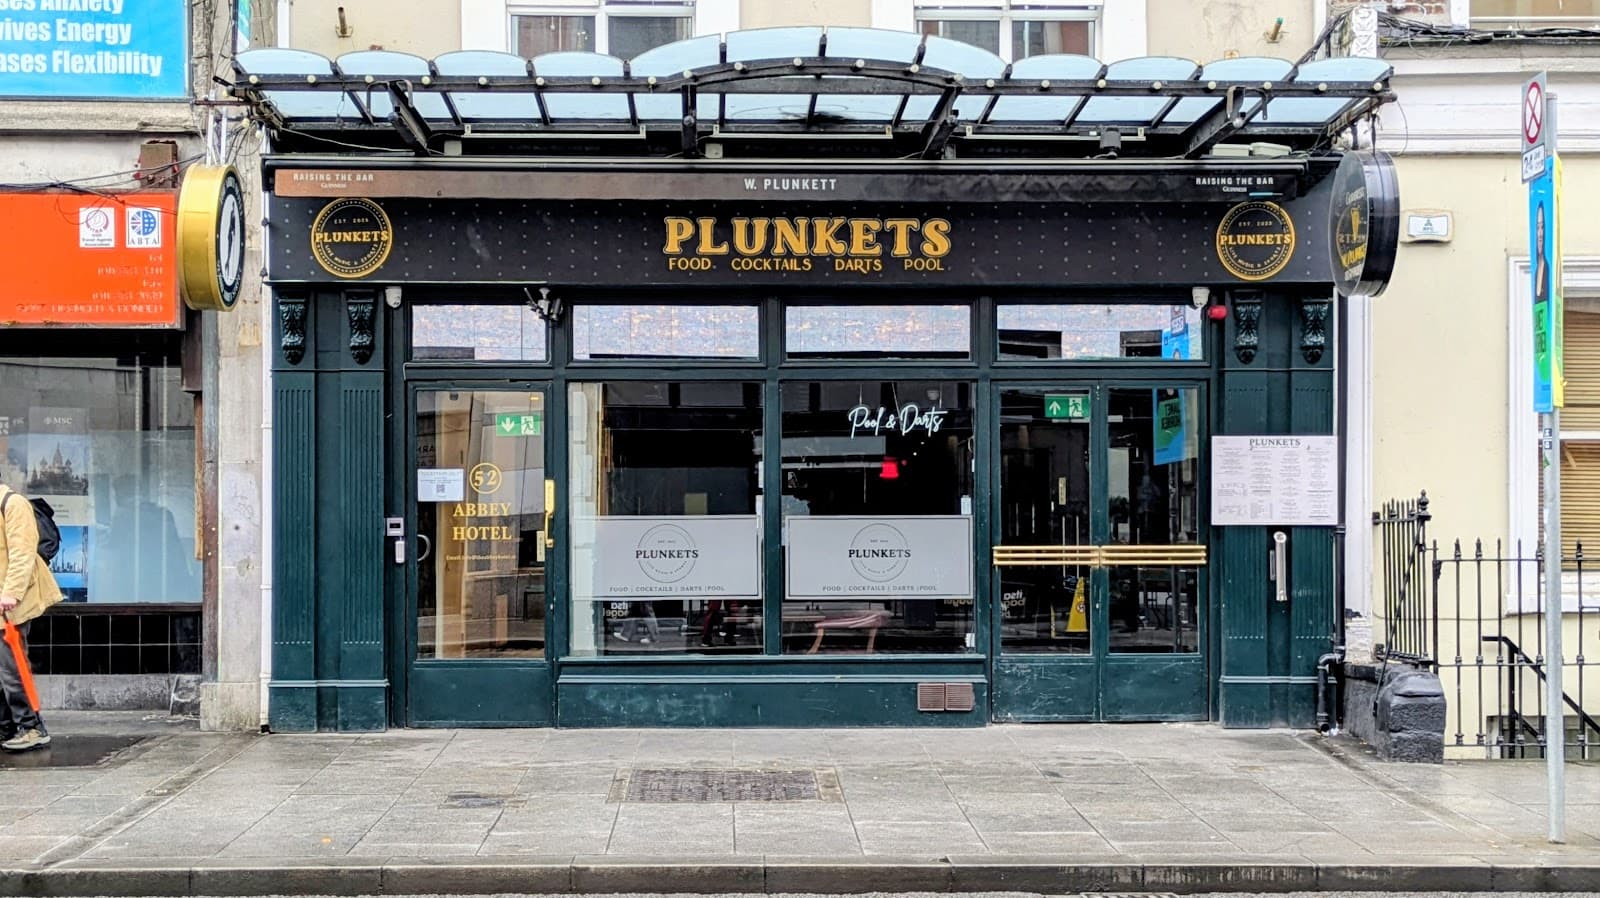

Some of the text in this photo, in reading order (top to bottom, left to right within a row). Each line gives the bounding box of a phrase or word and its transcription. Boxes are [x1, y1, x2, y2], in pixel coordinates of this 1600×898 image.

[56, 19, 132, 45] Energy
[52, 51, 163, 77] Flexibility
[293, 173, 374, 181] RAISING THE BAR
[744, 178, 837, 190] W. PLUNKETT
[1195, 177, 1274, 185] RAISING THE BAR
[315, 230, 390, 243] PLUNKETS
[662, 216, 952, 257] PLUNKETS
[1219, 233, 1292, 245] PLUNKETS
[668, 257, 944, 274] FOOD COCKTAILS DARTS POOL
[848, 404, 948, 439] Pool & Darts
[1249, 438, 1302, 447] PLUNKETS
[473, 470, 498, 487] 52
[452, 502, 513, 517] ABBEY
[452, 526, 513, 541] HOTEL
[635, 549, 700, 559] PLUNKETS
[848, 549, 912, 558] PLUNKETS
